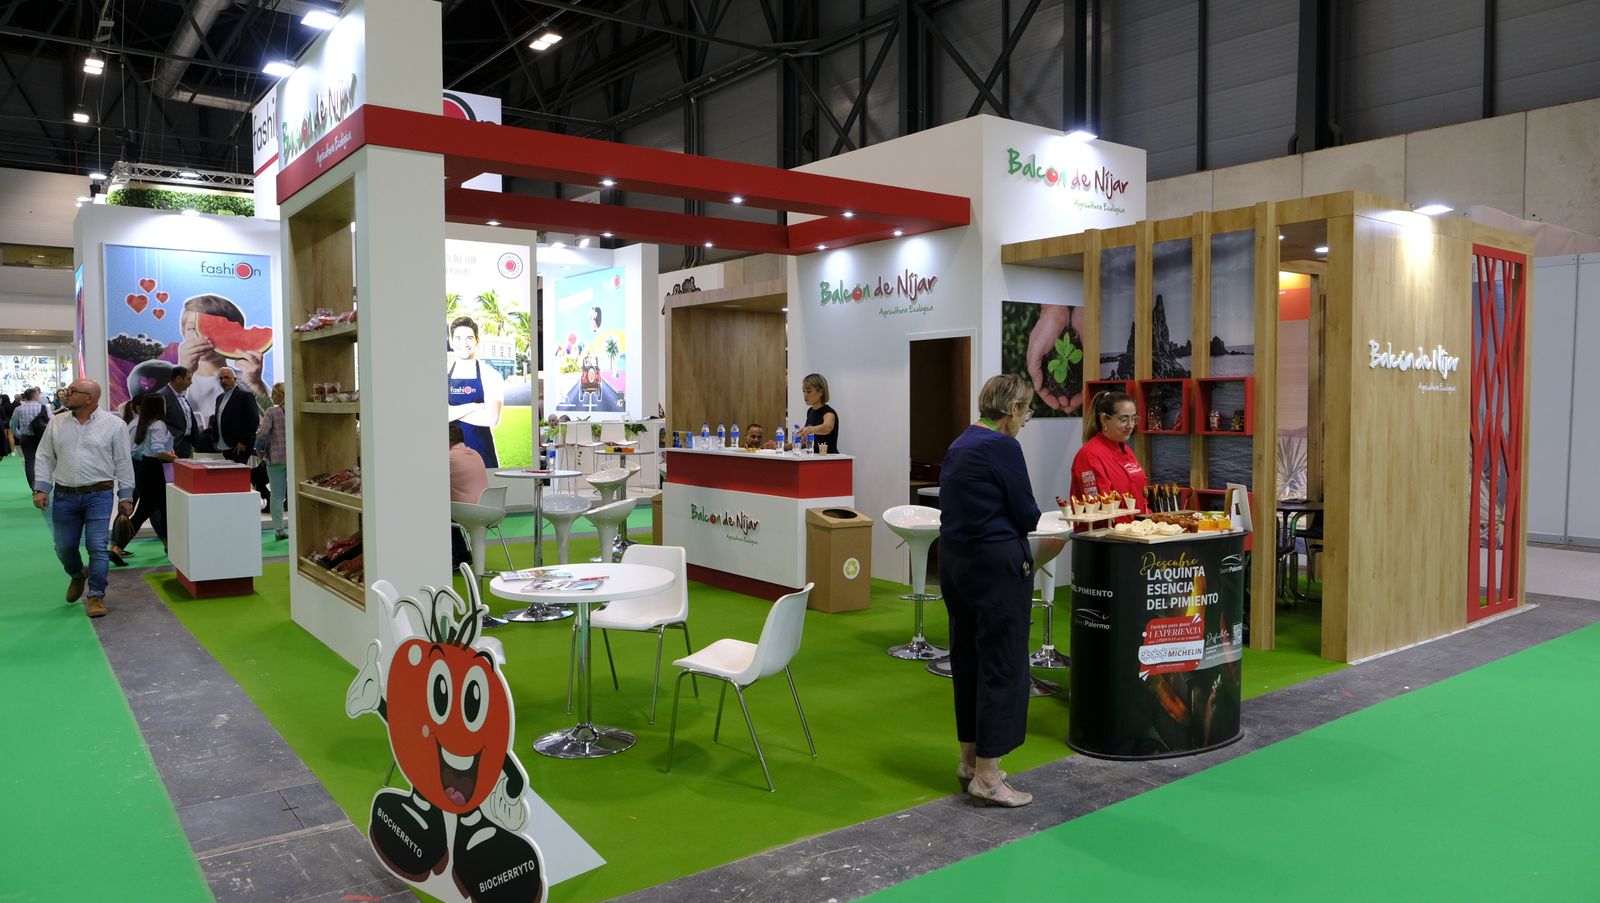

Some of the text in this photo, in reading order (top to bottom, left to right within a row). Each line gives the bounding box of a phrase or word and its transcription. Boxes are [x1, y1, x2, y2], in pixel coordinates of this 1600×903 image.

[1071, 168, 1091, 191] de
[874, 276, 895, 298] de
[1415, 346, 1433, 370] de
[722, 511, 735, 527] de
[1146, 565, 1206, 582] LA QUINTA
[1078, 586, 1114, 598] PIMIENTO
[1146, 581, 1195, 596] ESENCIA
[1146, 592, 1219, 611] DEL PIMIENTO
[1167, 647, 1203, 657] MICHELIN
[377, 807, 423, 859] BIOCHERRYTO
[478, 859, 536, 894] BIOCHERRYTO
